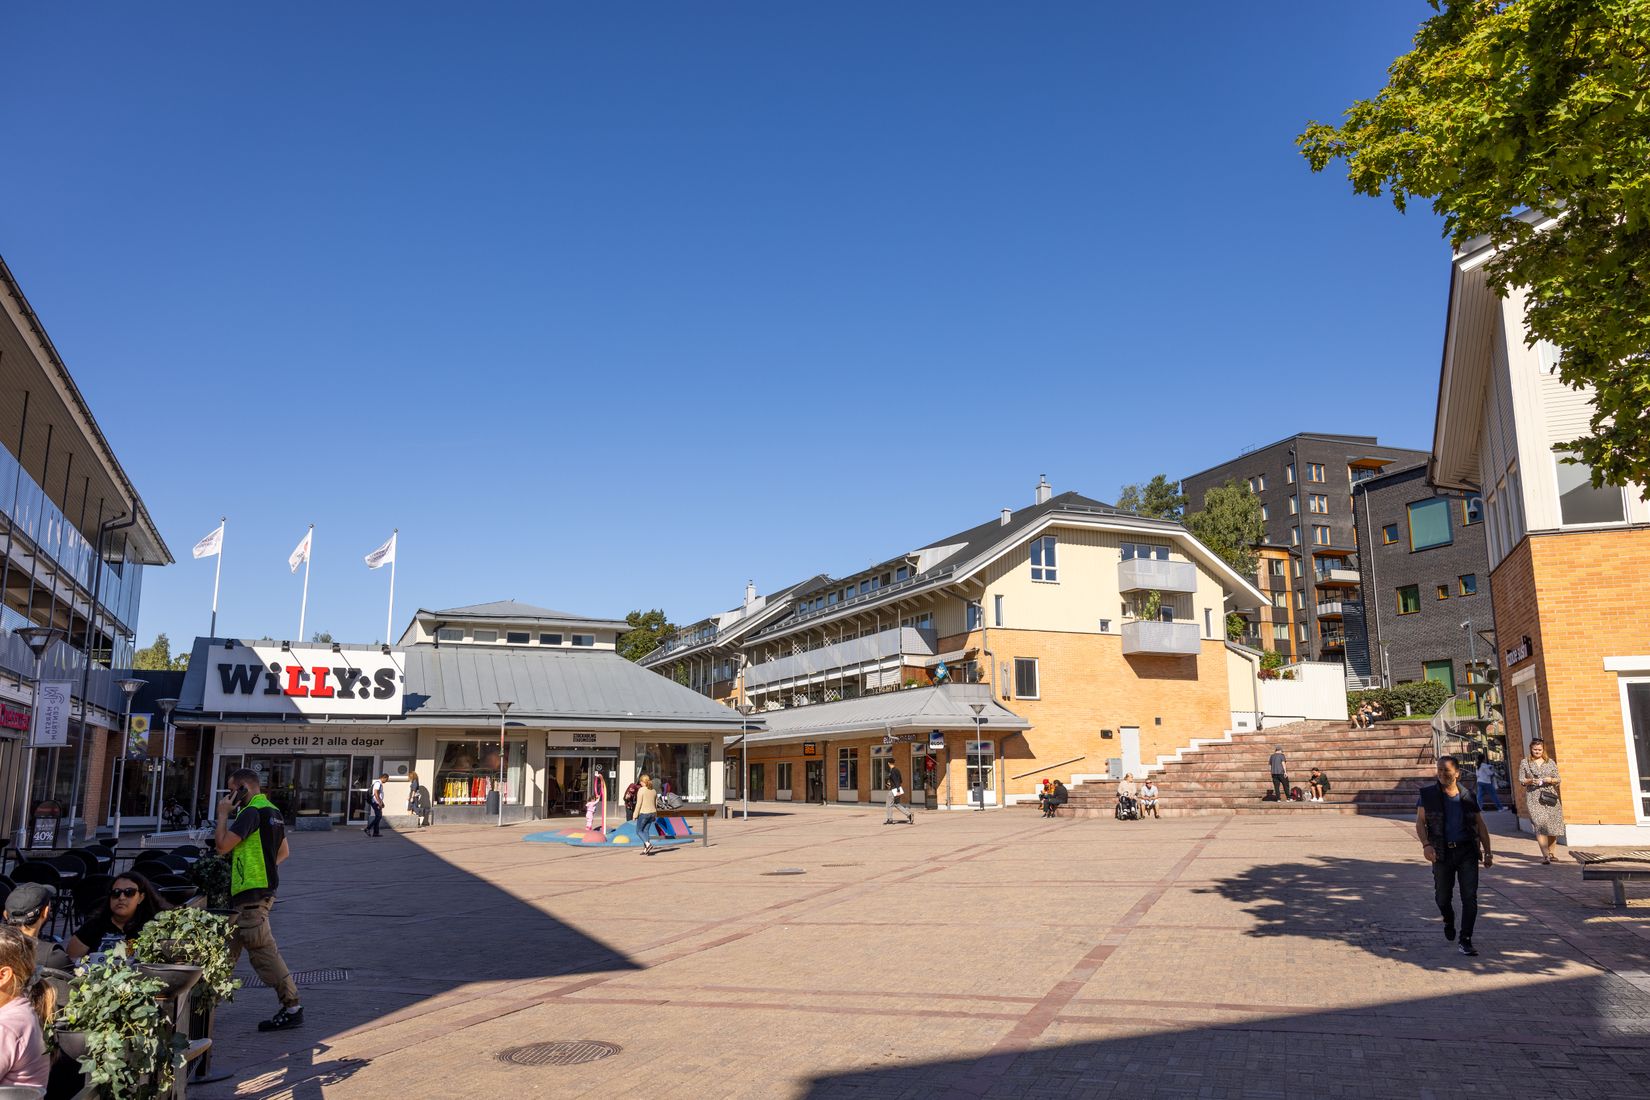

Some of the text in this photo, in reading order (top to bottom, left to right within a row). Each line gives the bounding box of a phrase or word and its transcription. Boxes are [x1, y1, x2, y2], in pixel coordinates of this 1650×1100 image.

[251, 734, 385, 748] Öppet till 21 alla dagar
[33, 831, 54, 841] 40%
